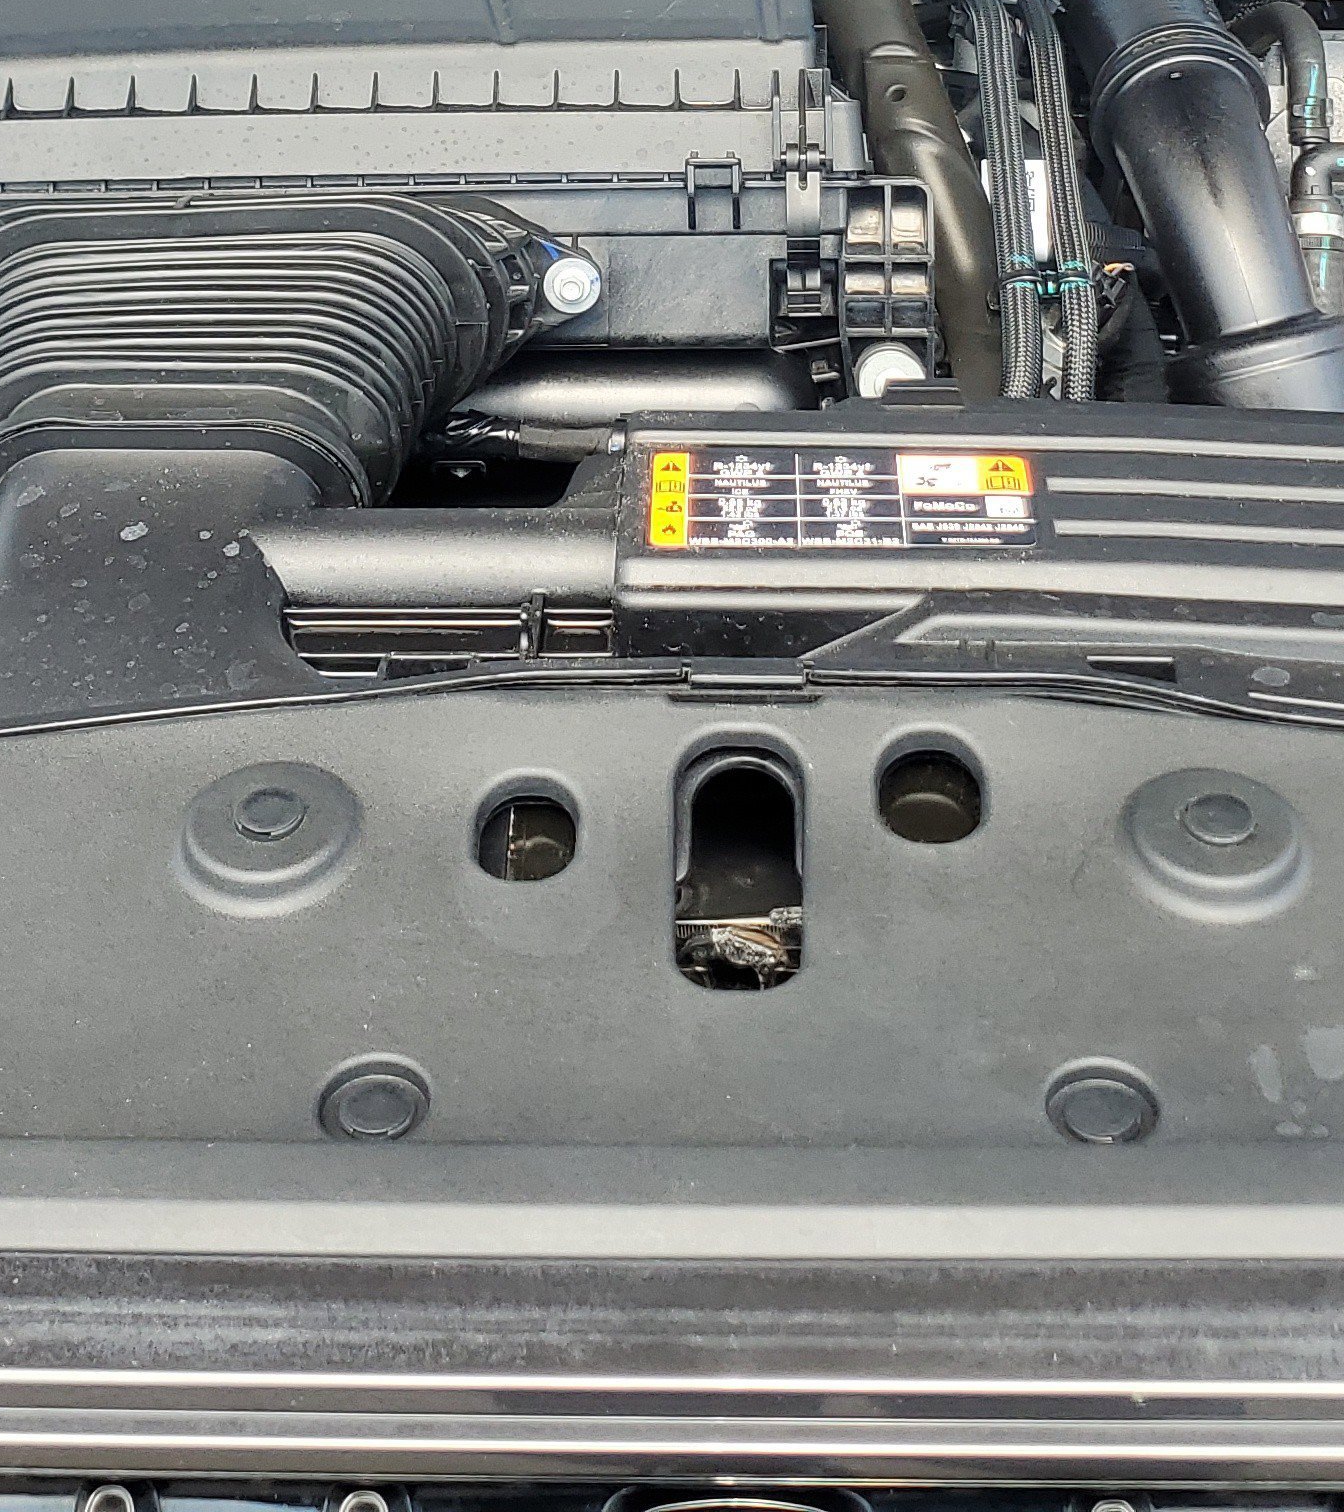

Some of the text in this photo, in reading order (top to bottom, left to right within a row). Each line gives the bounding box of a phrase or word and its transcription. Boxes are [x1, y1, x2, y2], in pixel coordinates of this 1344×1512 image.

[714, 478, 768, 487] NAUTILUS
[816, 479, 870, 488] NAUTILUS
[913, 500, 978, 512] FoMoCo
